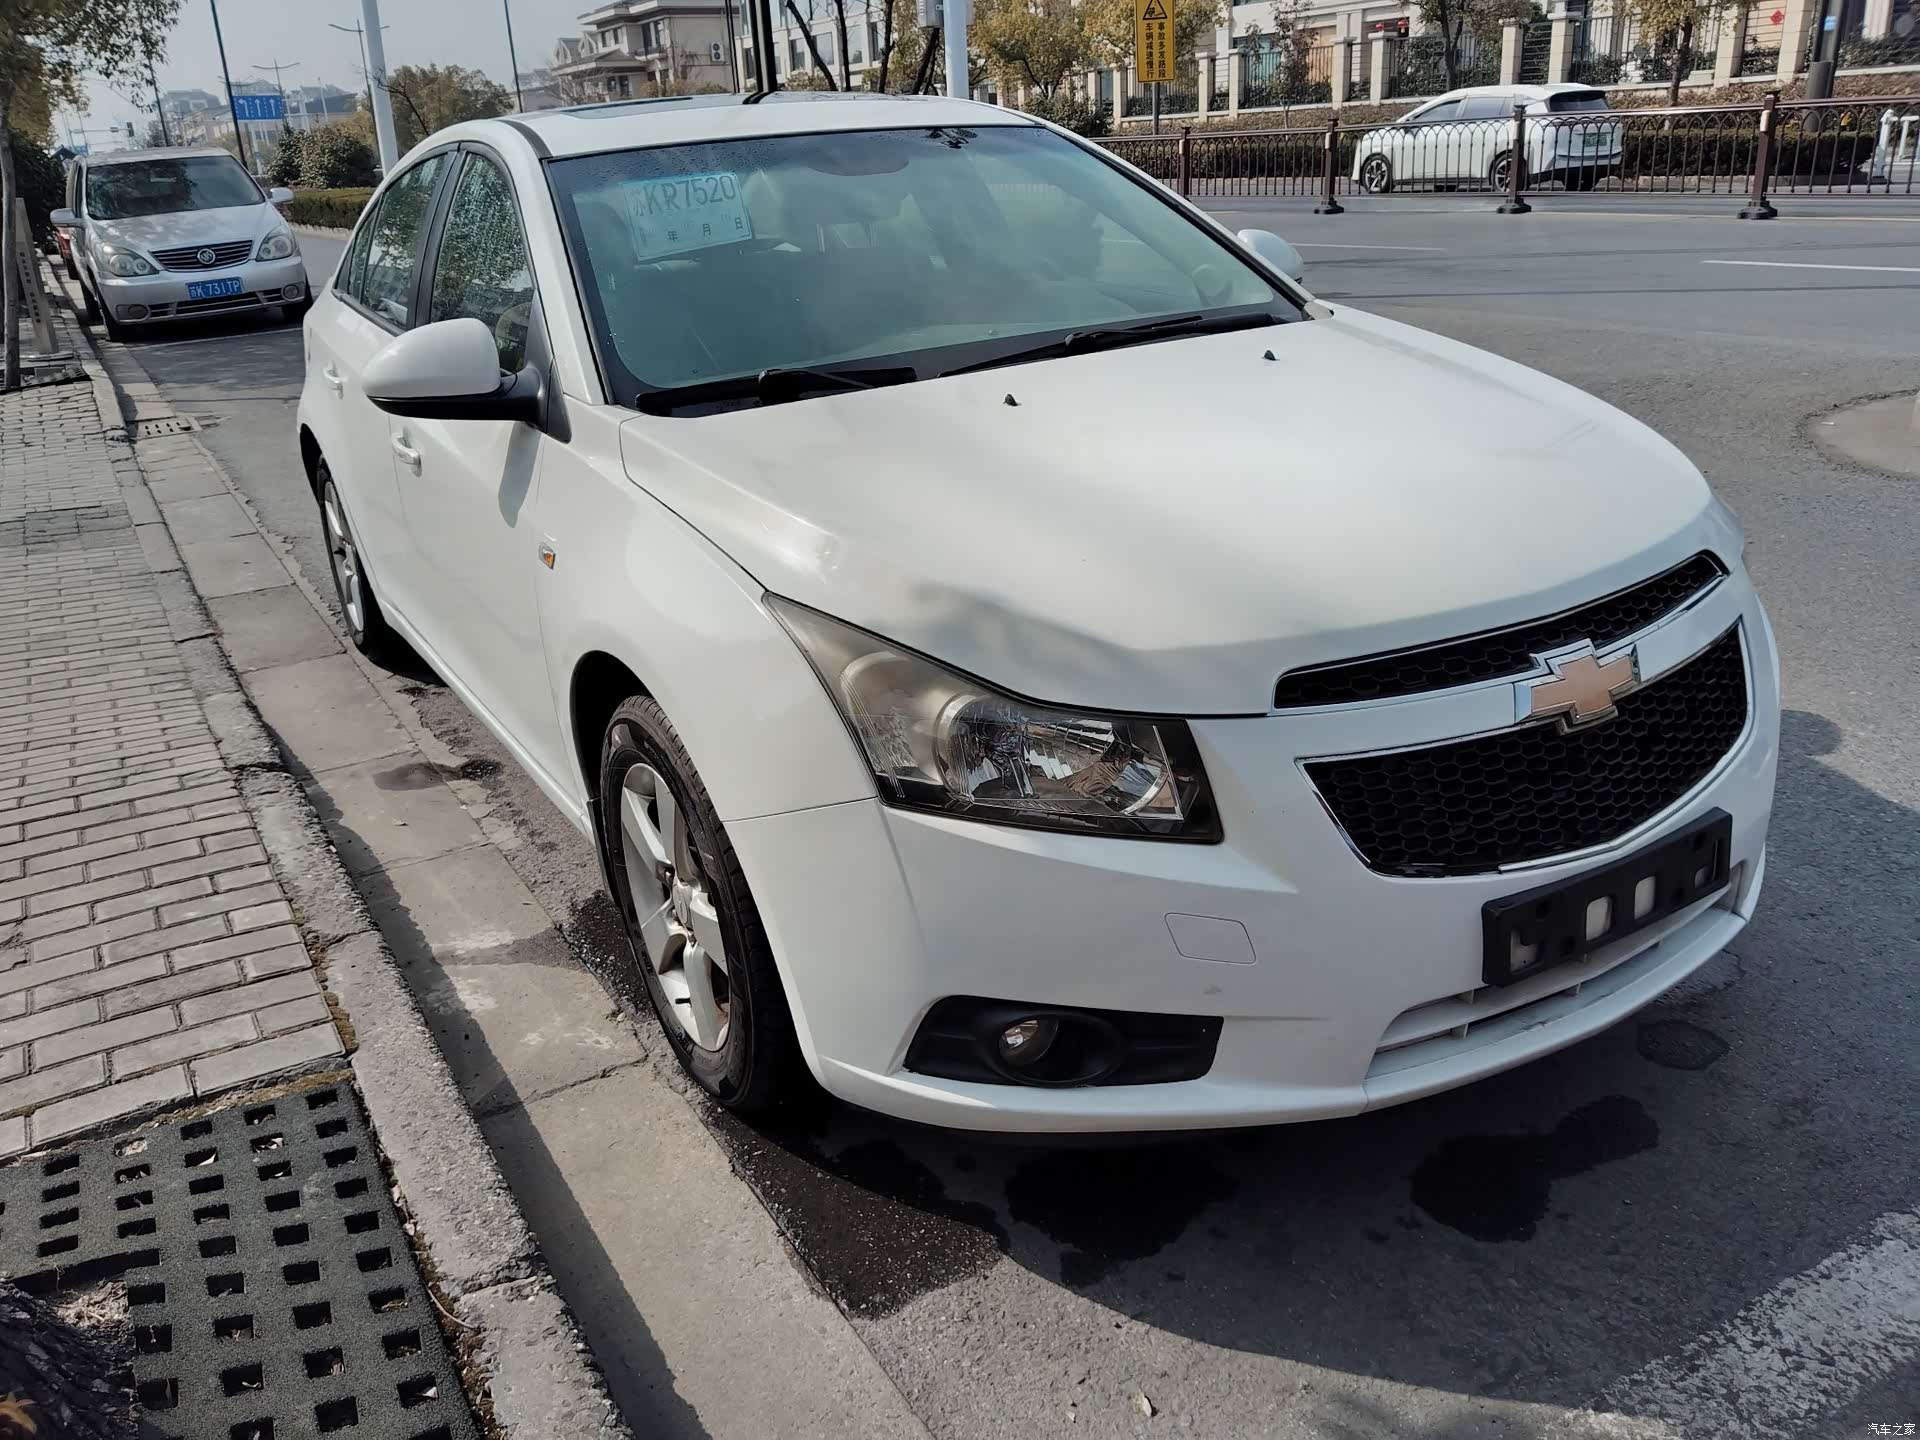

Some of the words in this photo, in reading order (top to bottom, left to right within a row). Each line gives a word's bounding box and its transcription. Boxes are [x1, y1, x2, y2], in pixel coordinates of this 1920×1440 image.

[1145, 22, 1154, 79] 车辆减速慢行
[1157, 22, 1166, 78] 事故多发路段
[702, 223, 711, 236] 月
